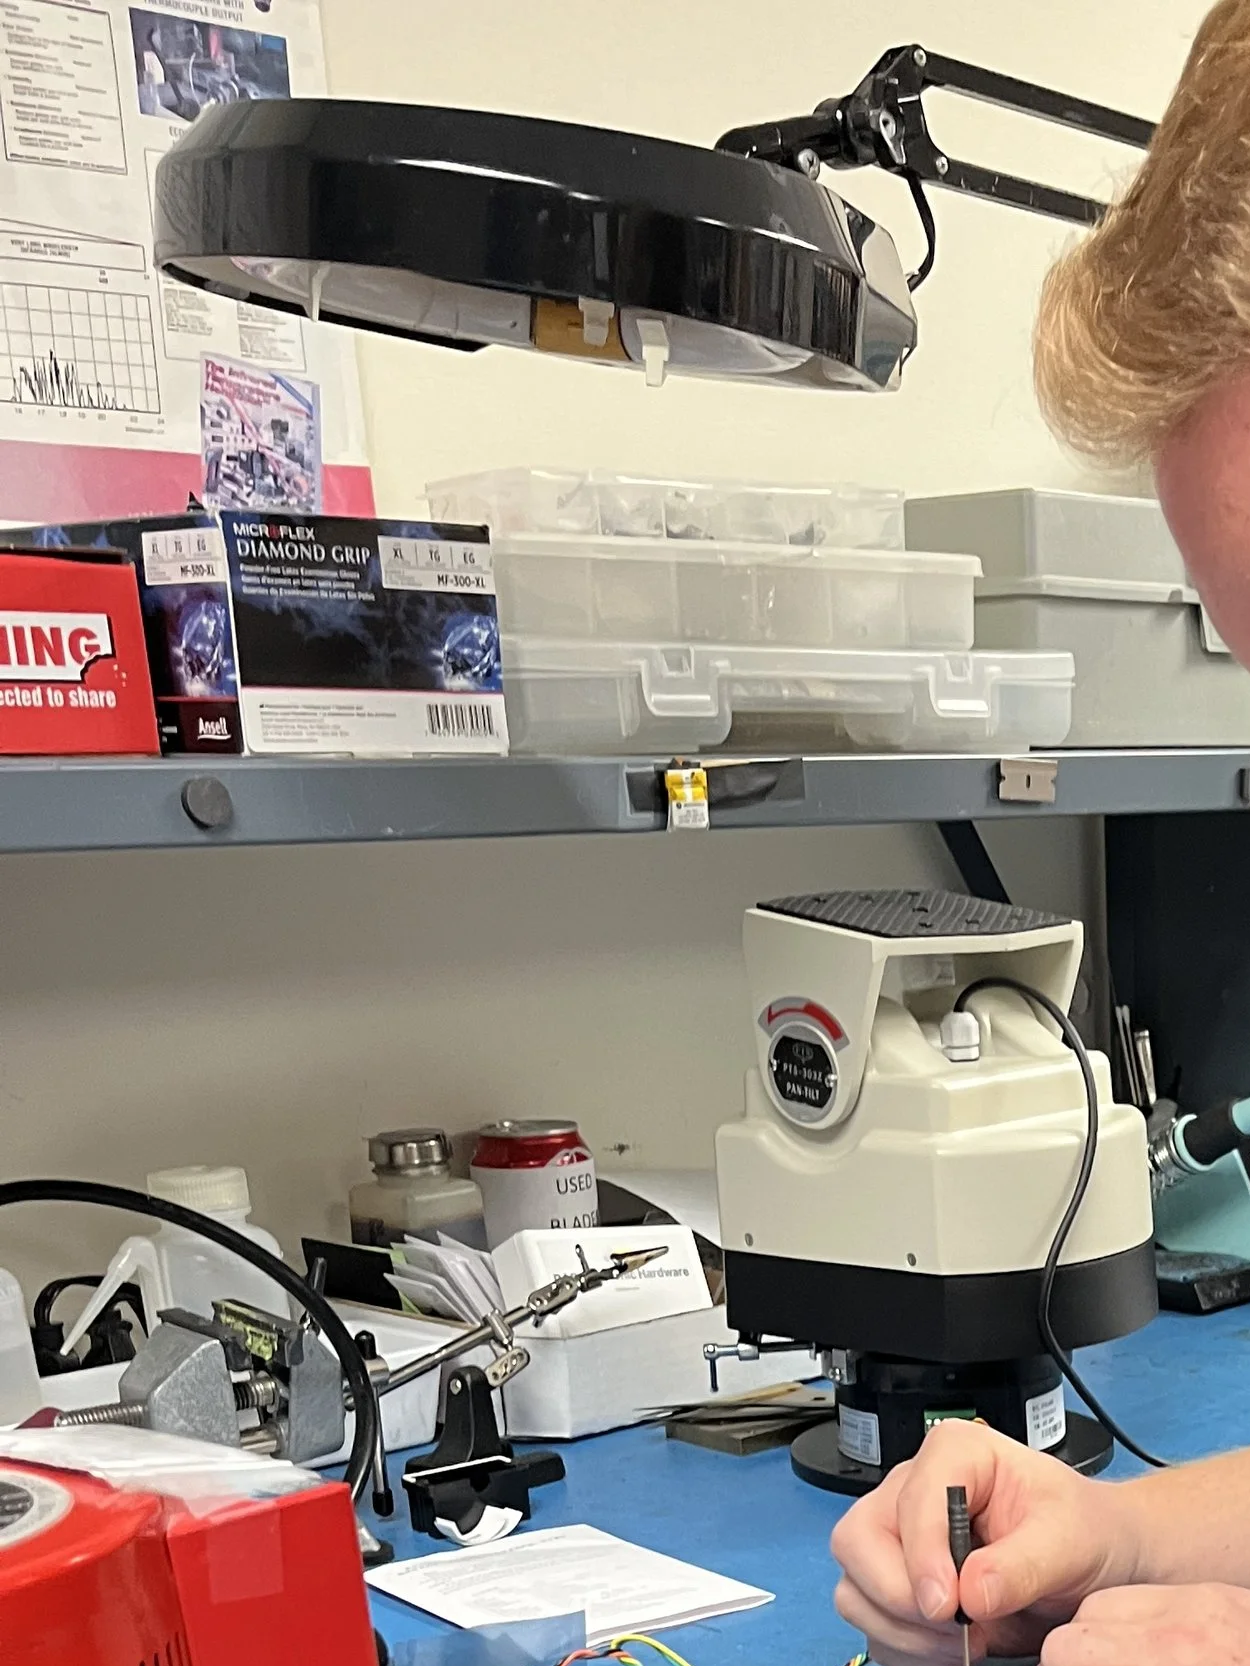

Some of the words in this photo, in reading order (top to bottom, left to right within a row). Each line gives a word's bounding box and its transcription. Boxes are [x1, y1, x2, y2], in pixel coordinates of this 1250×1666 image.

[236, 539, 326, 563] DIAMOND
[331, 546, 371, 565] GRIP
[437, 574, 487, 588] MF-300-XL
[47, 686, 64, 708] to
[69, 690, 117, 708] share
[198, 716, 229, 735] Ansell
[556, 1172, 592, 1195] USED
[638, 1266, 690, 1281] Hardware
